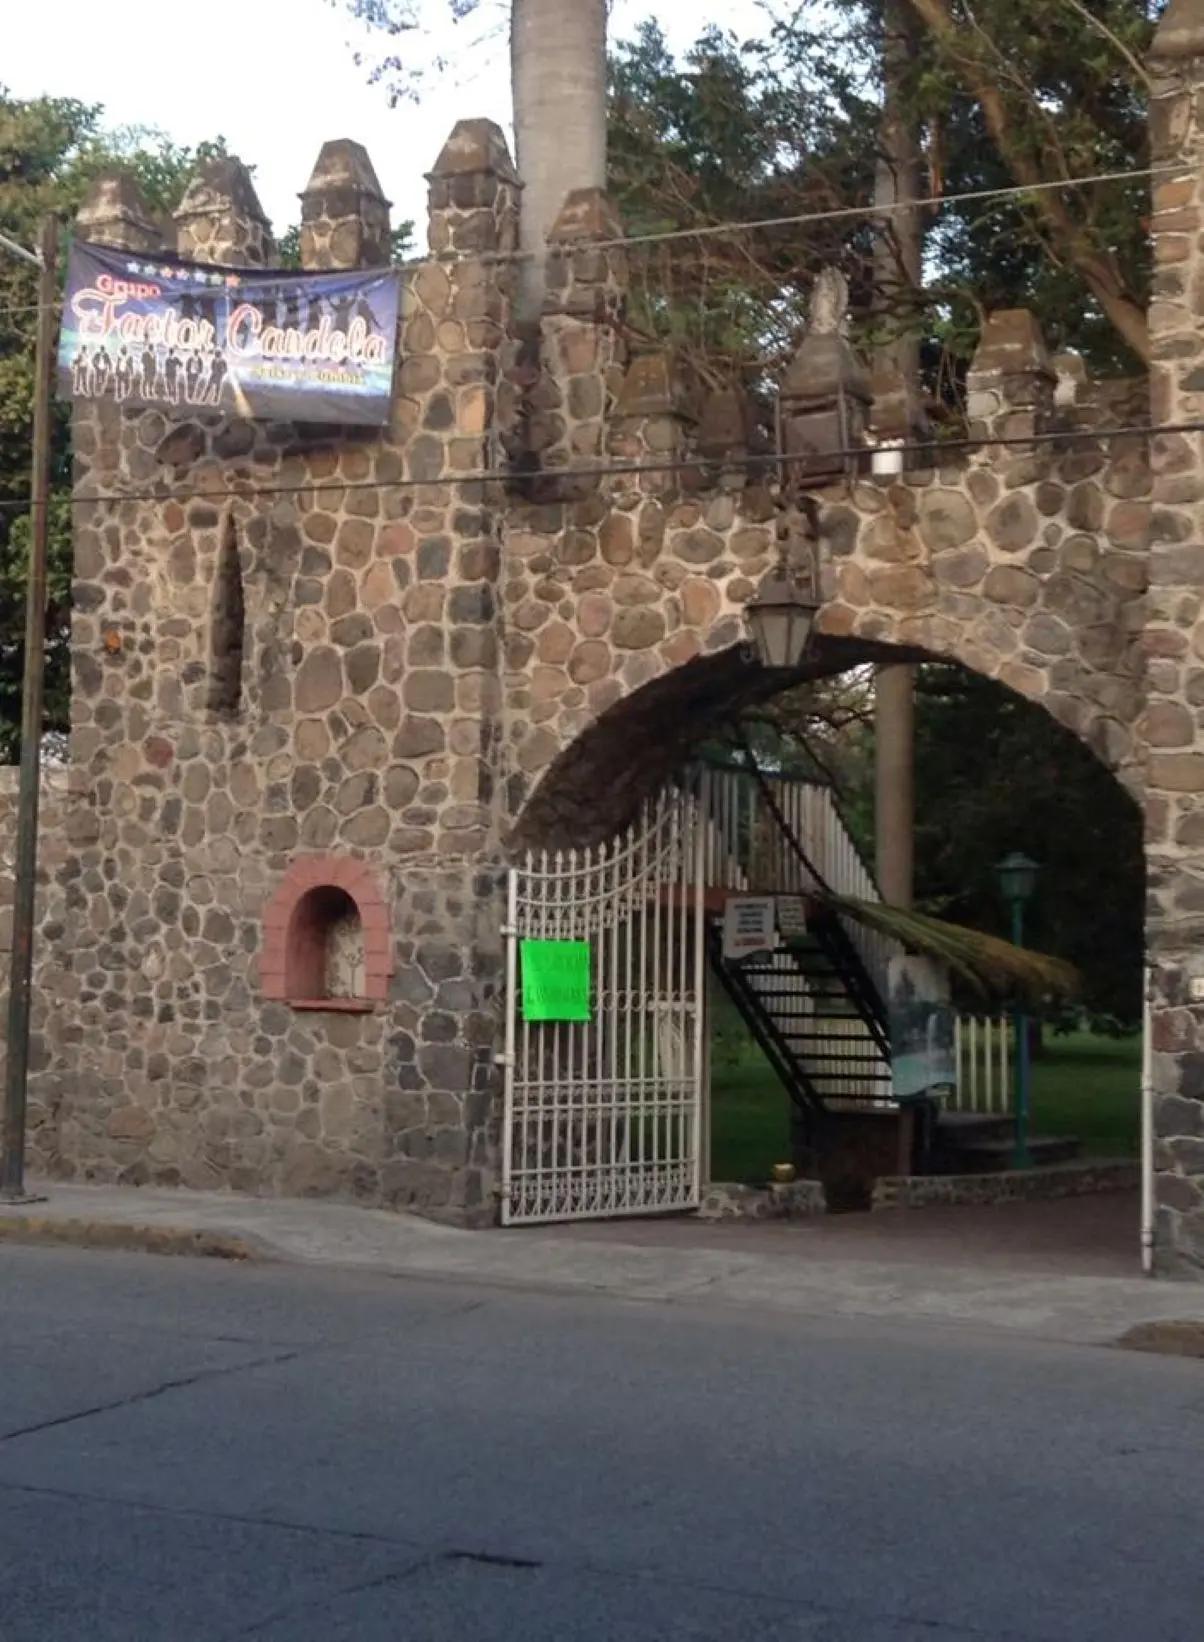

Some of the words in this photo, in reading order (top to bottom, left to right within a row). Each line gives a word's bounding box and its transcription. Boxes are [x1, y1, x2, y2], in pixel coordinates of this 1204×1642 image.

[95, 274, 161, 298] Grupo
[71, 288, 216, 350] Factor
[227, 303, 387, 364] Candela
